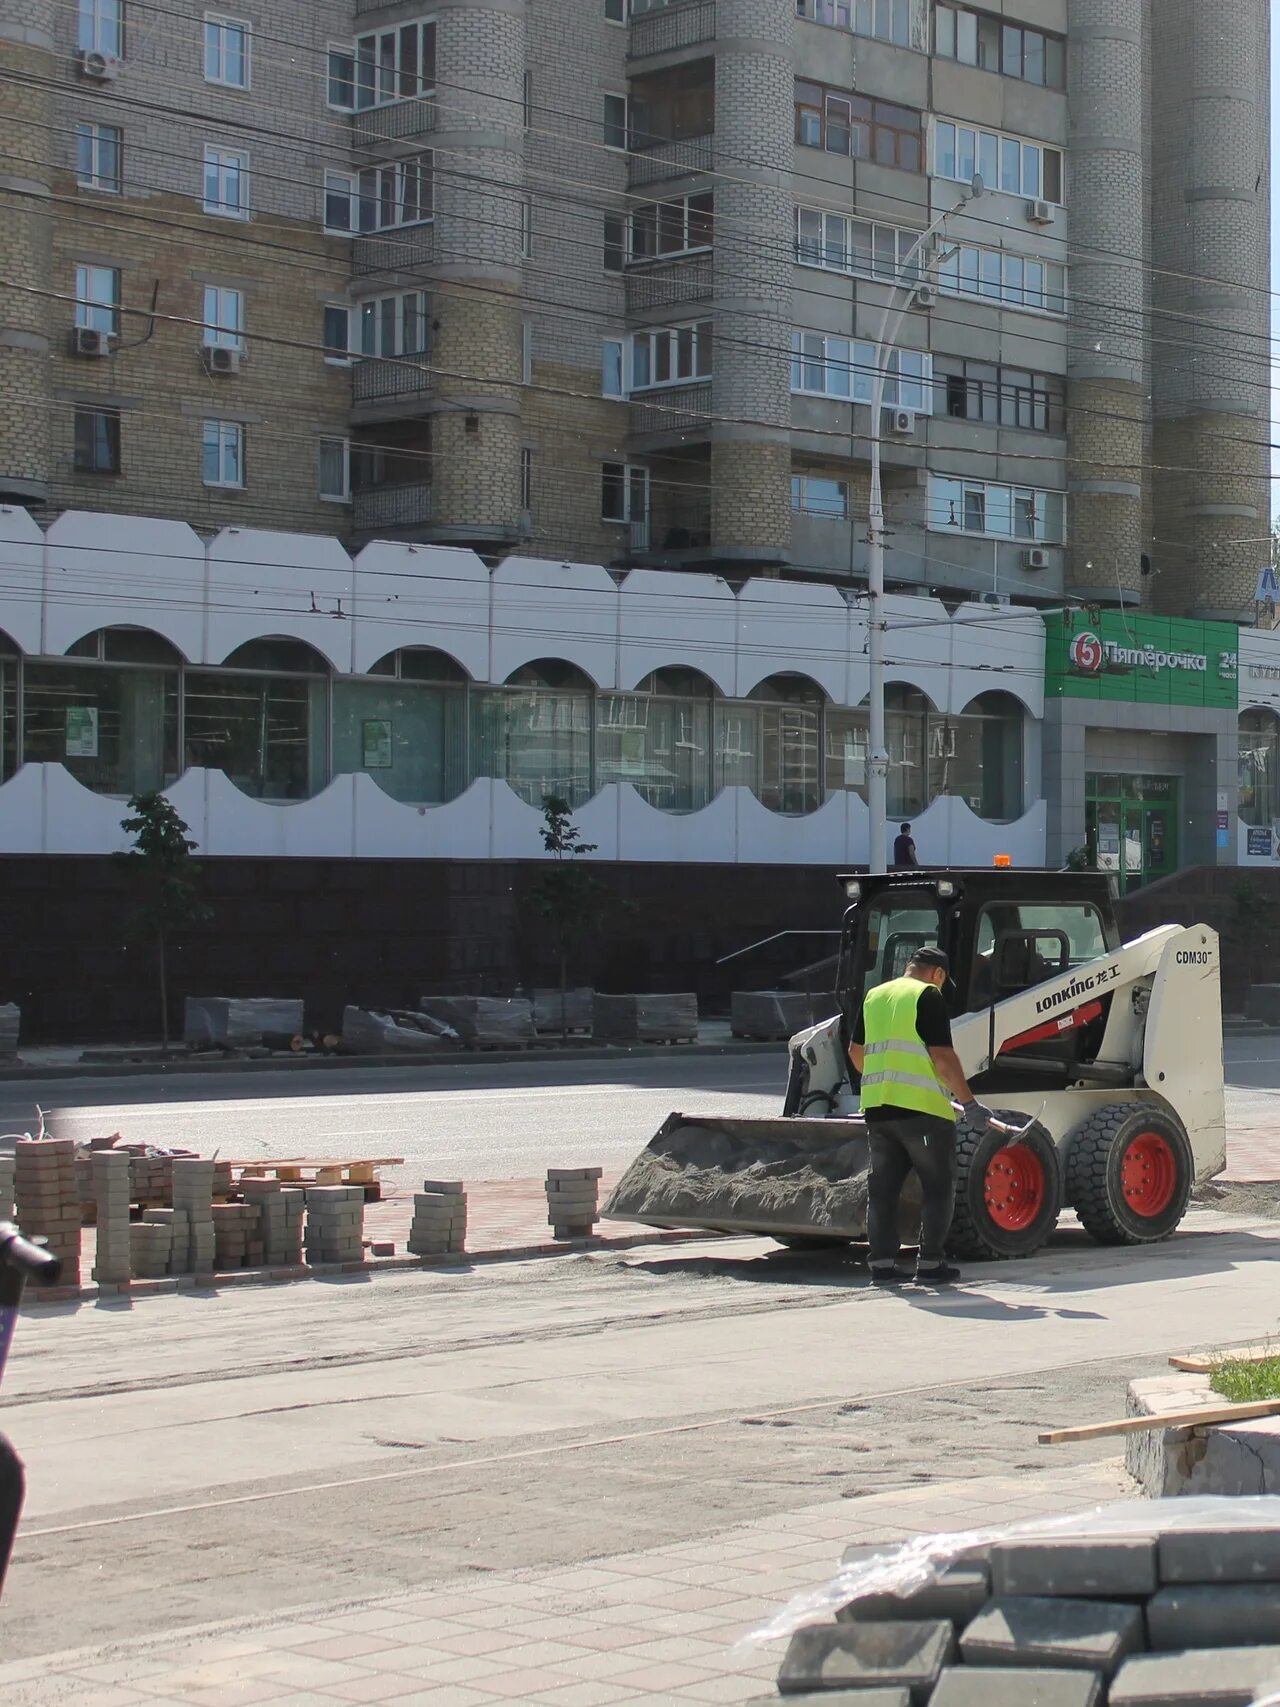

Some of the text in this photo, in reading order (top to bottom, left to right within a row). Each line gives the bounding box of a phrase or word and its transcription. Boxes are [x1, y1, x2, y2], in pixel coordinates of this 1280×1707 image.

[1103, 640, 1207, 672] Пятёрочка
[1219, 652, 1237, 669] 24
[1176, 951, 1212, 965] CDM30
[1096, 964, 1121, 985] 龙工
